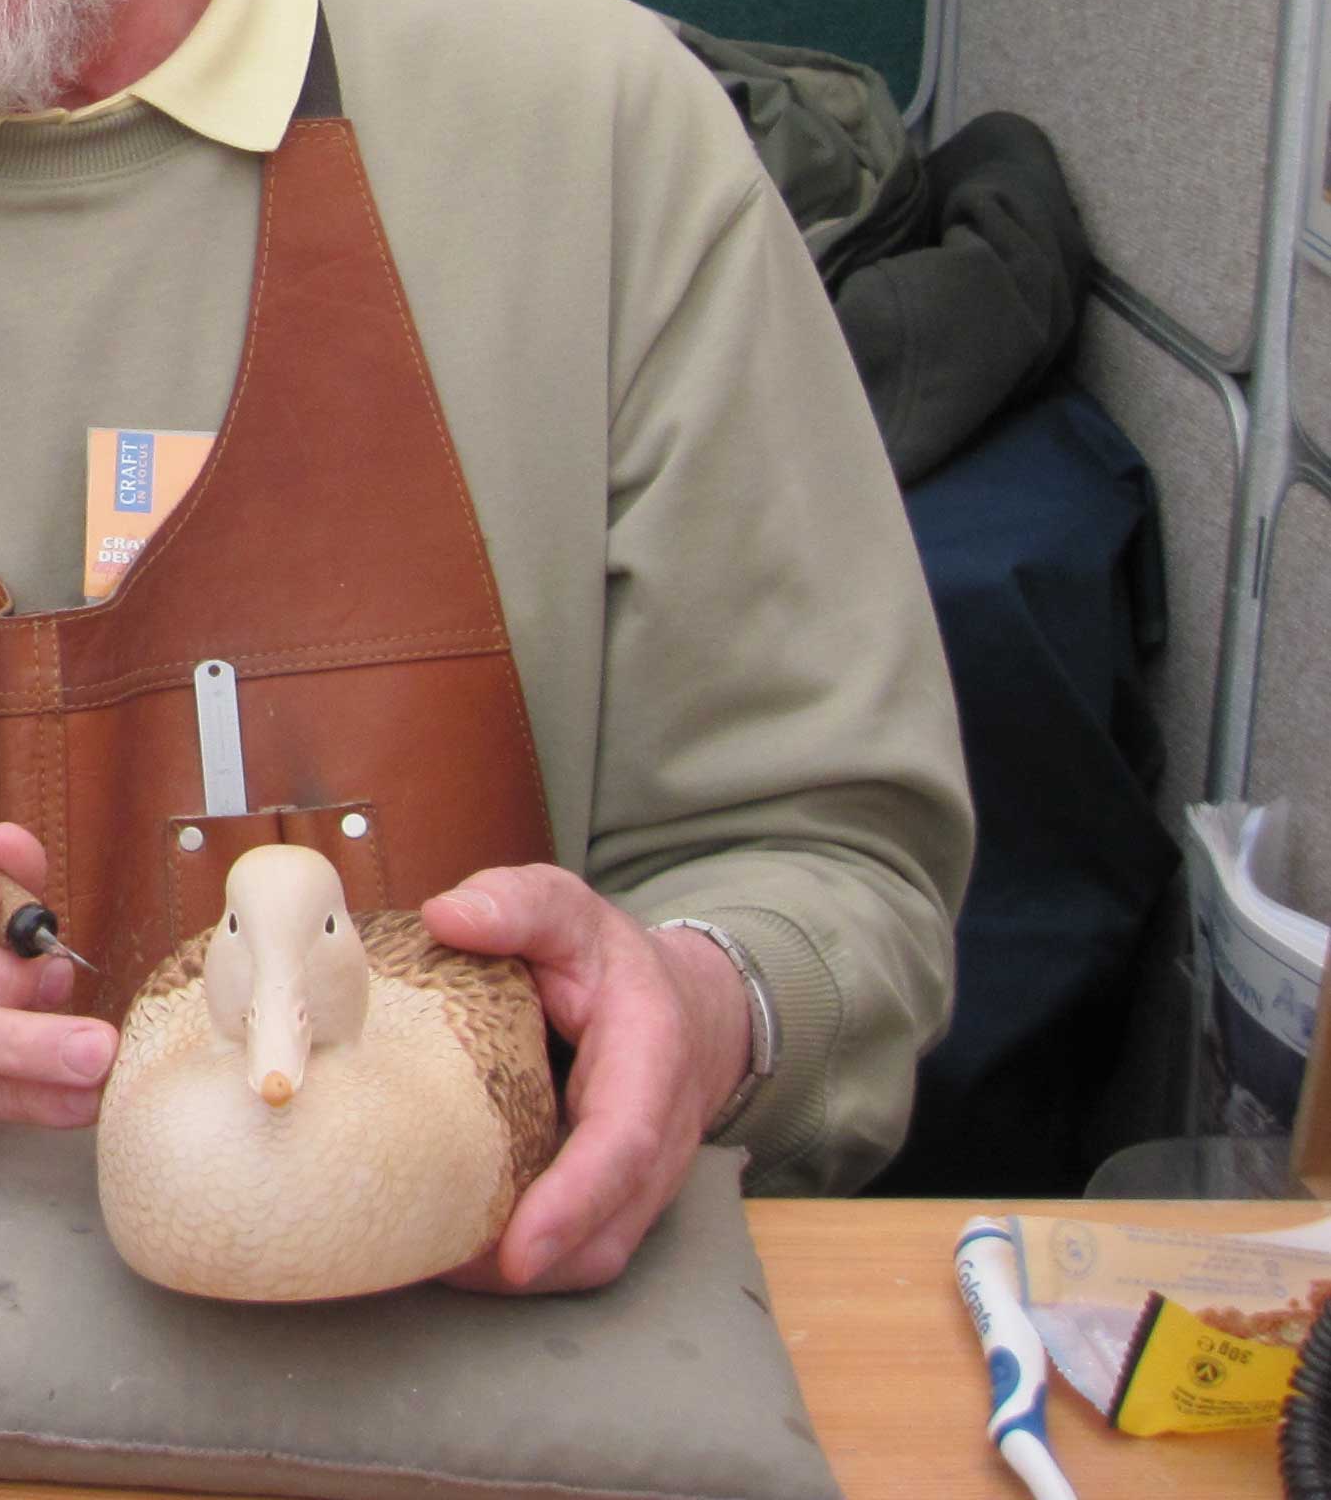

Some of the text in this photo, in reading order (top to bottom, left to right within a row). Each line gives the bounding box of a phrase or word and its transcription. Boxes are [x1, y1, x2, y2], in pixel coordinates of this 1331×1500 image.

[119, 440, 138, 505] CRAFT
[137, 443, 149, 503] IN FOCUS
[99, 551, 133, 564] DES
[103, 536, 146, 550] CRA
